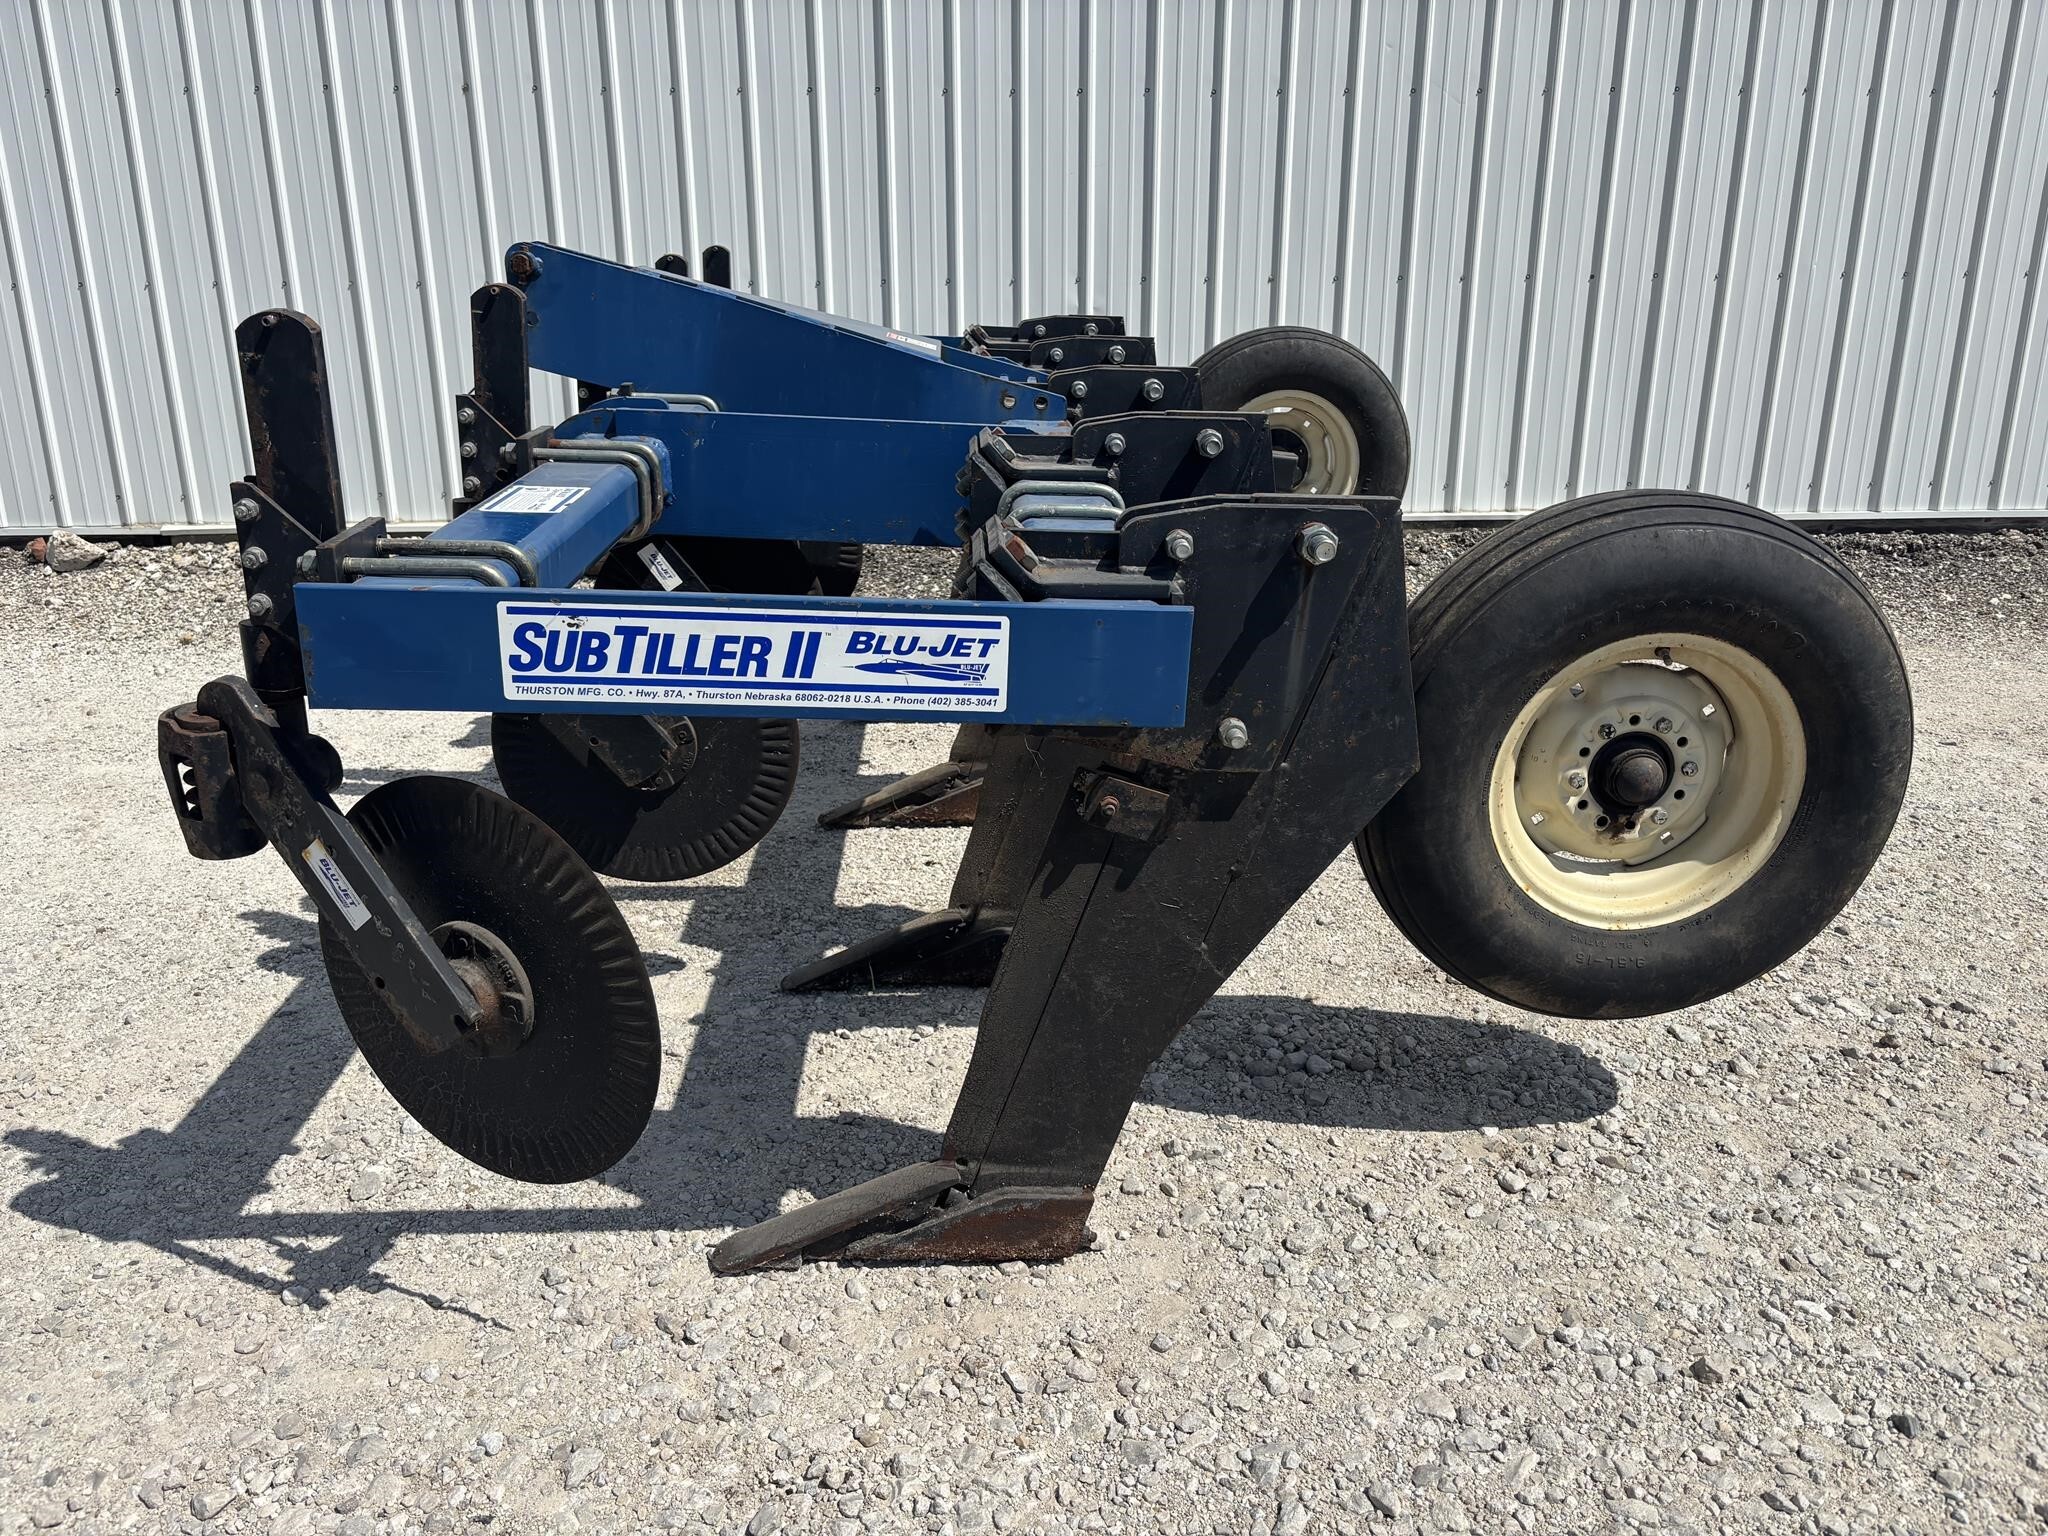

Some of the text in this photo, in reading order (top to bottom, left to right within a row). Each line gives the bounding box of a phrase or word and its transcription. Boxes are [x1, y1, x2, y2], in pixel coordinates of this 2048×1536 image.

[509, 622, 773, 678] SUBTILLER
[845, 631, 1001, 658] BLU-JET
[515, 686, 998, 708] THURSTON MFG. CO. Hwy. 87A, Thurston Nebraska 68062-0218 U.S.A. Phone (402) 385-3041
[319, 858, 358, 908] BLU-JET
